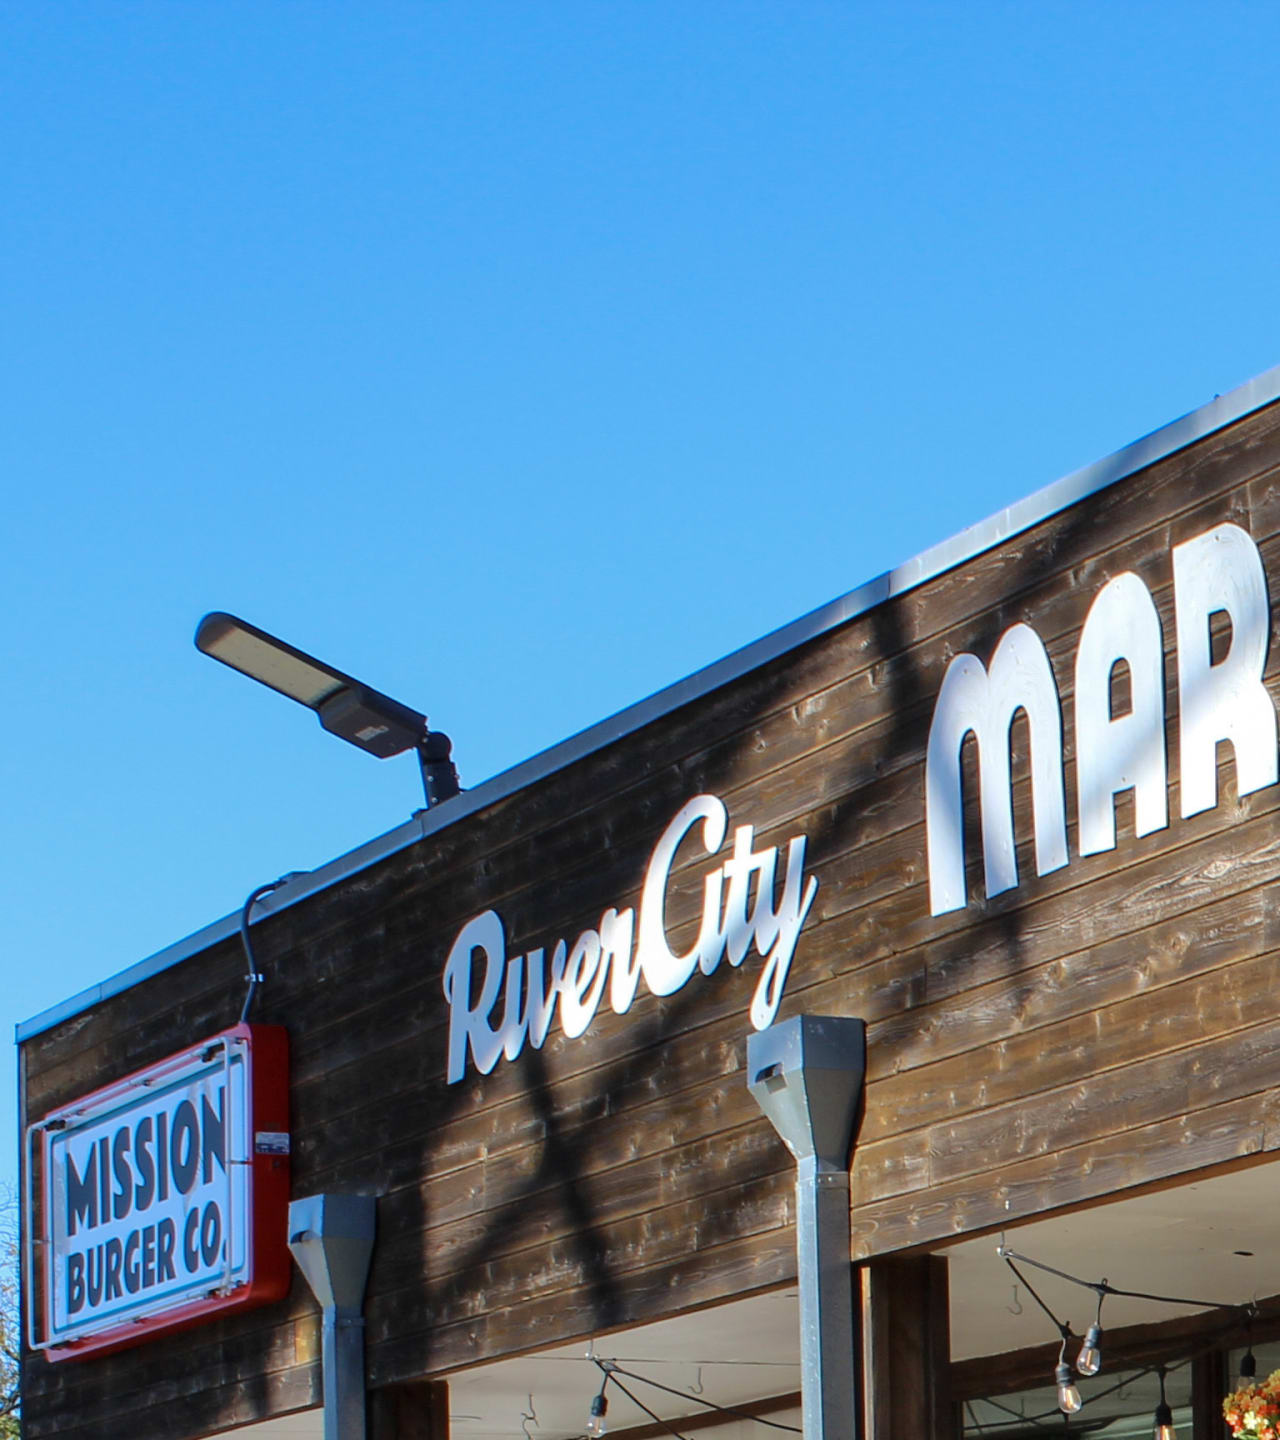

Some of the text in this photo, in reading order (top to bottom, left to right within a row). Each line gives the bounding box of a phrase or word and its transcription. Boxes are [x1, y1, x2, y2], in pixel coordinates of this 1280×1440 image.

[64, 1085, 226, 1238] MISSION
[67, 1200, 228, 1315] BURGER CO.
